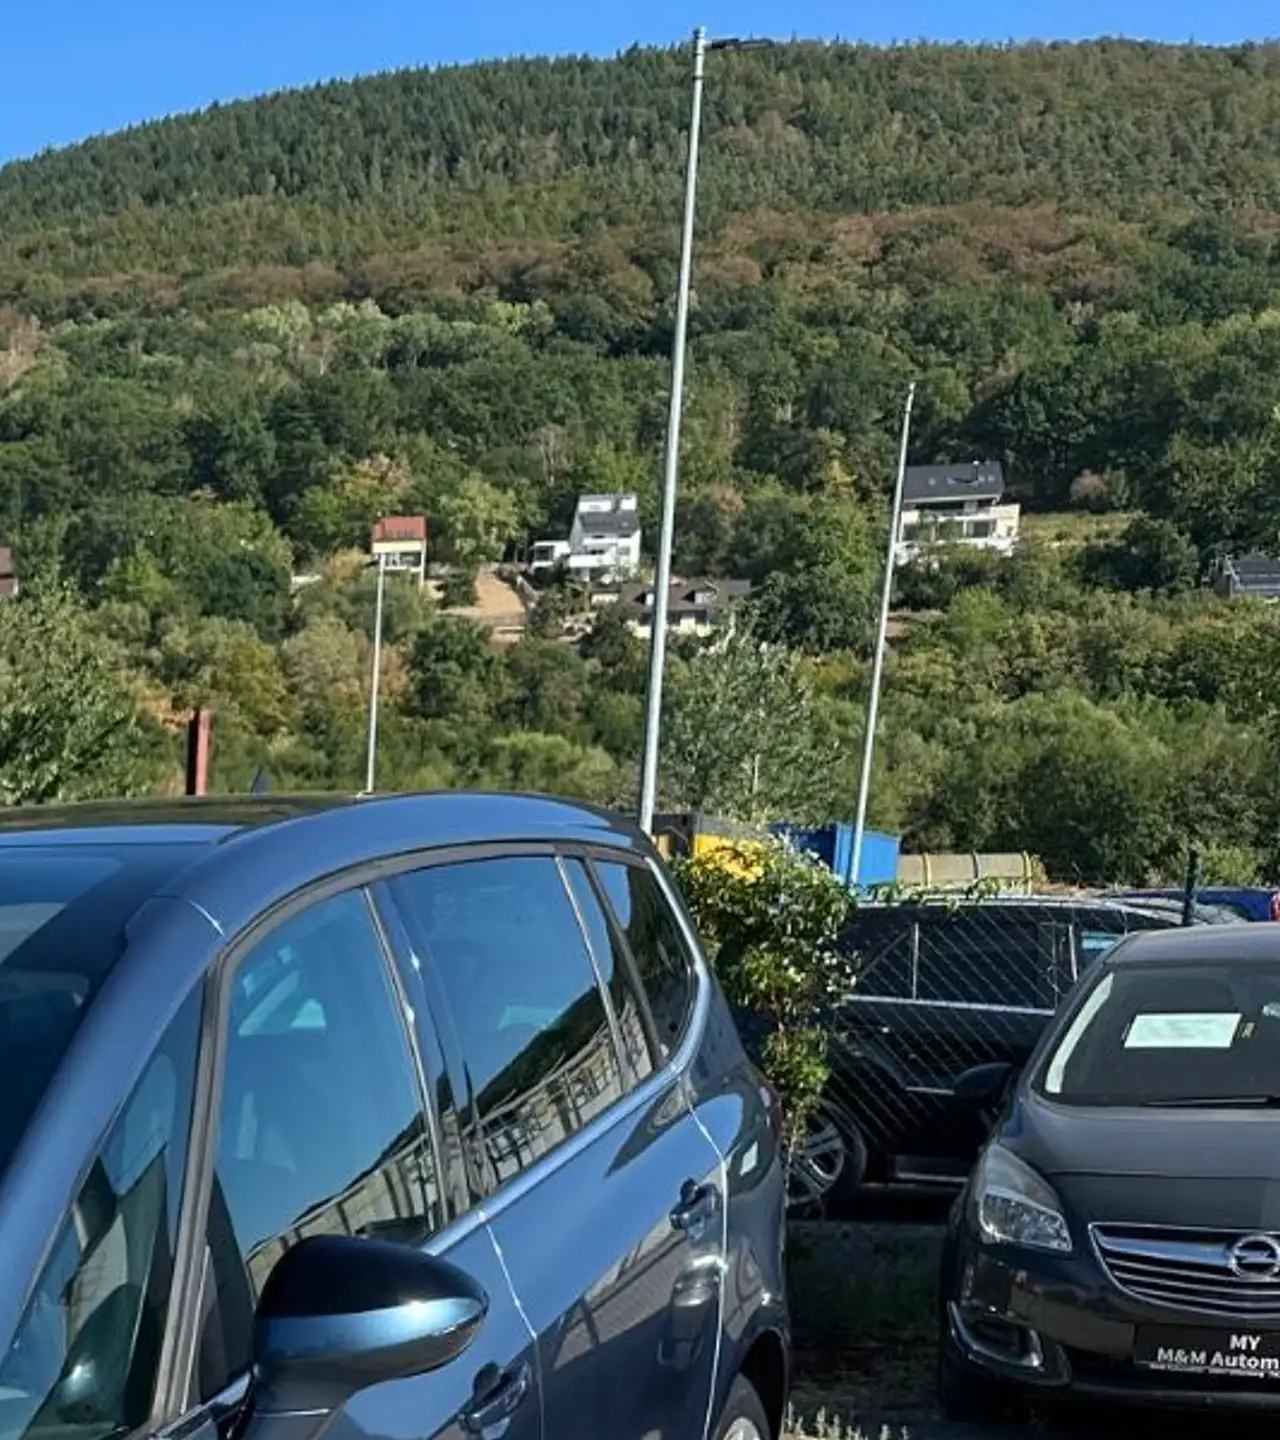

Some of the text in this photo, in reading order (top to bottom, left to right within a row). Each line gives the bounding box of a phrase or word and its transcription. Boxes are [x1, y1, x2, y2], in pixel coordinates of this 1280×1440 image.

[1229, 1333, 1261, 1351] MY
[1157, 1347, 1280, 1370] M&M Autom
